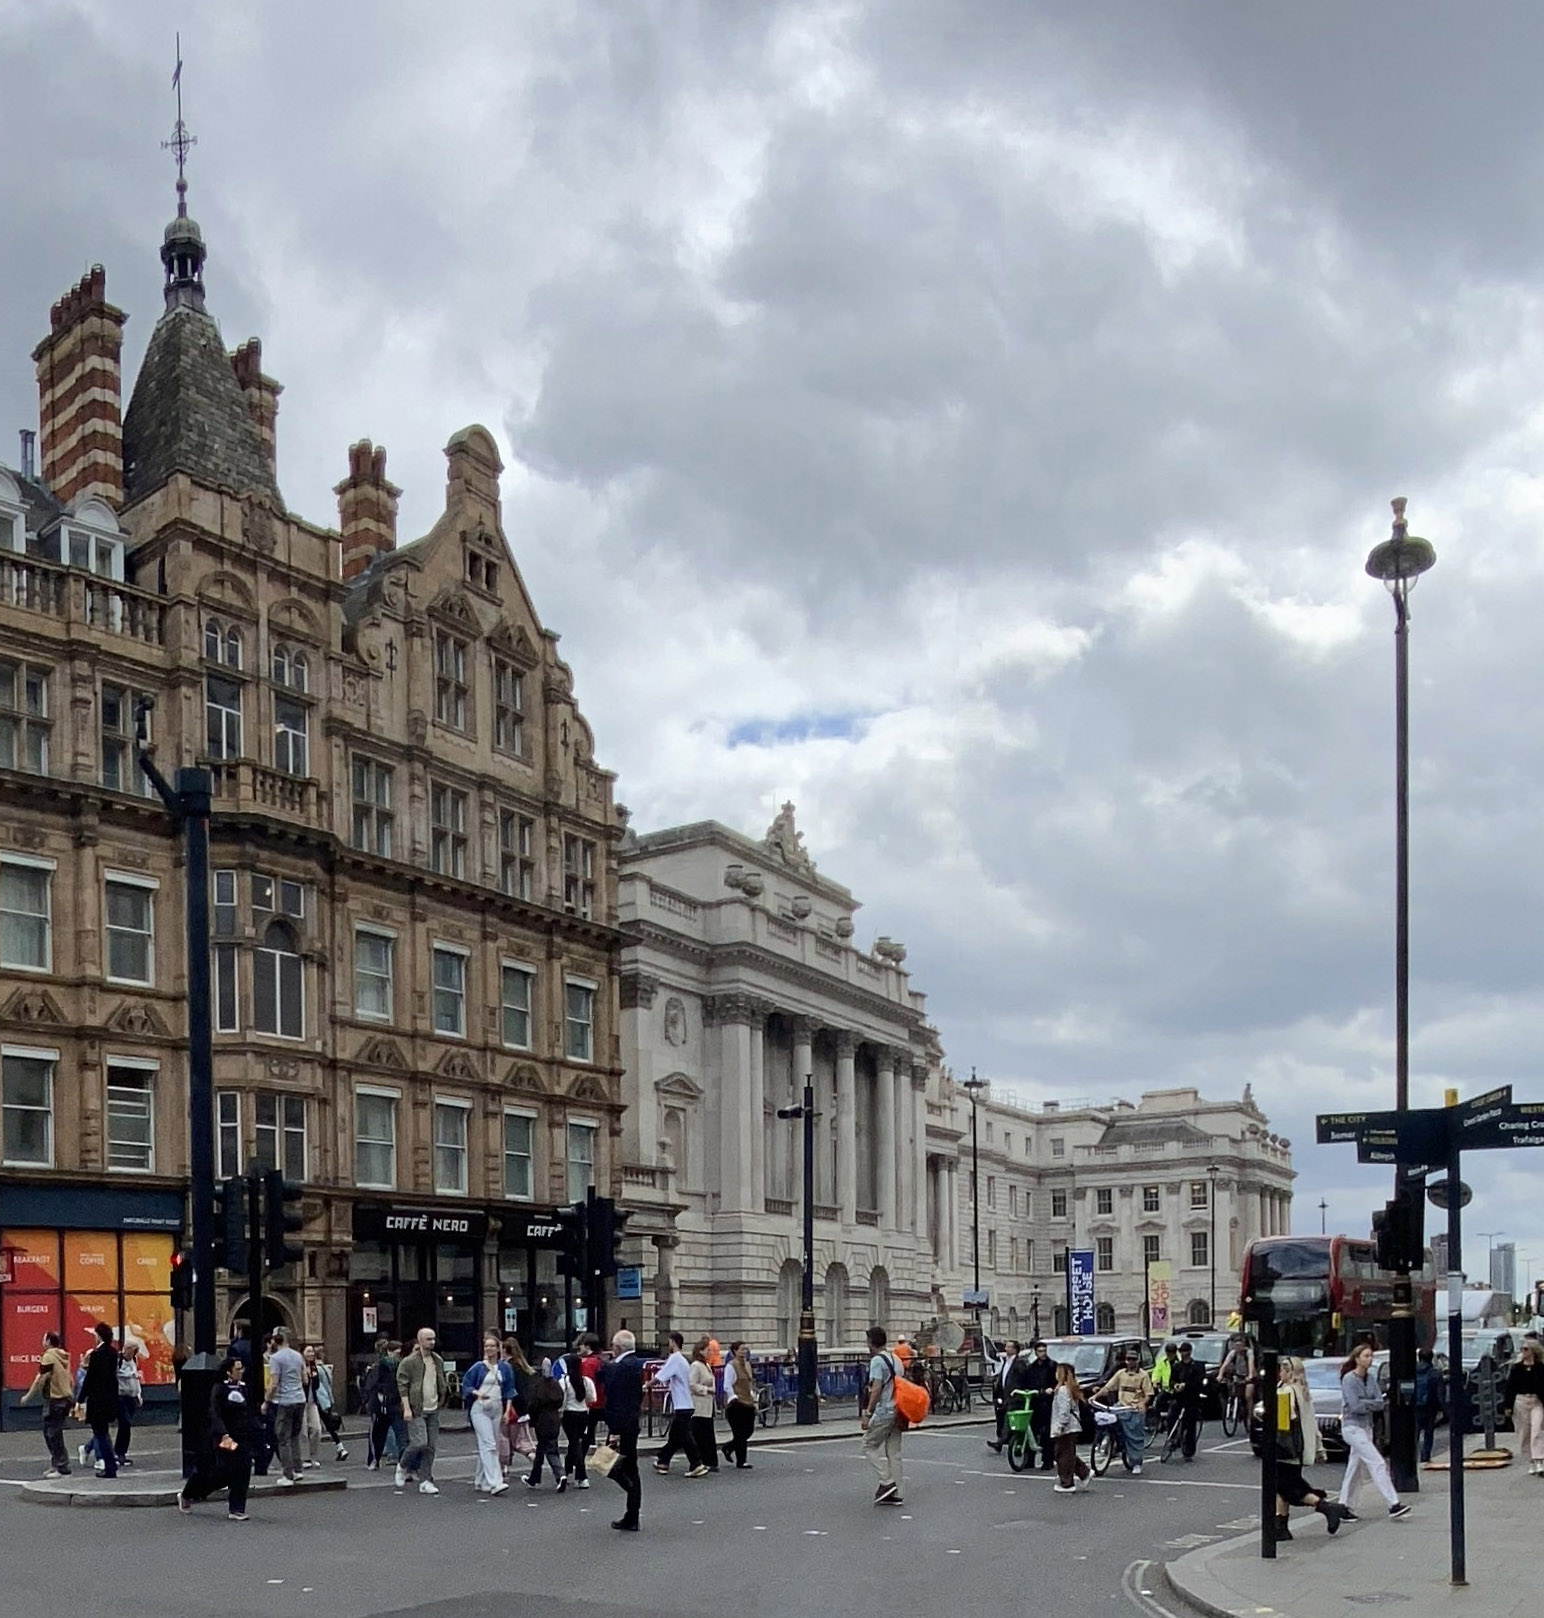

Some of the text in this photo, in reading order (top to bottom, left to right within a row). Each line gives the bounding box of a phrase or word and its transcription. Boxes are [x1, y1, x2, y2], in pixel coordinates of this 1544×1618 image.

[1331, 1115, 1366, 1125] THE CITY
[1498, 1122, 1529, 1130] Charing
[1330, 1131, 1356, 1140] Somer
[385, 1214, 469, 1232] CAFFÈ NERO
[79, 1257, 105, 1266] COFFEE
[16, 1305, 49, 1314] BURGERS
[30, 1355, 42, 1364] BO
